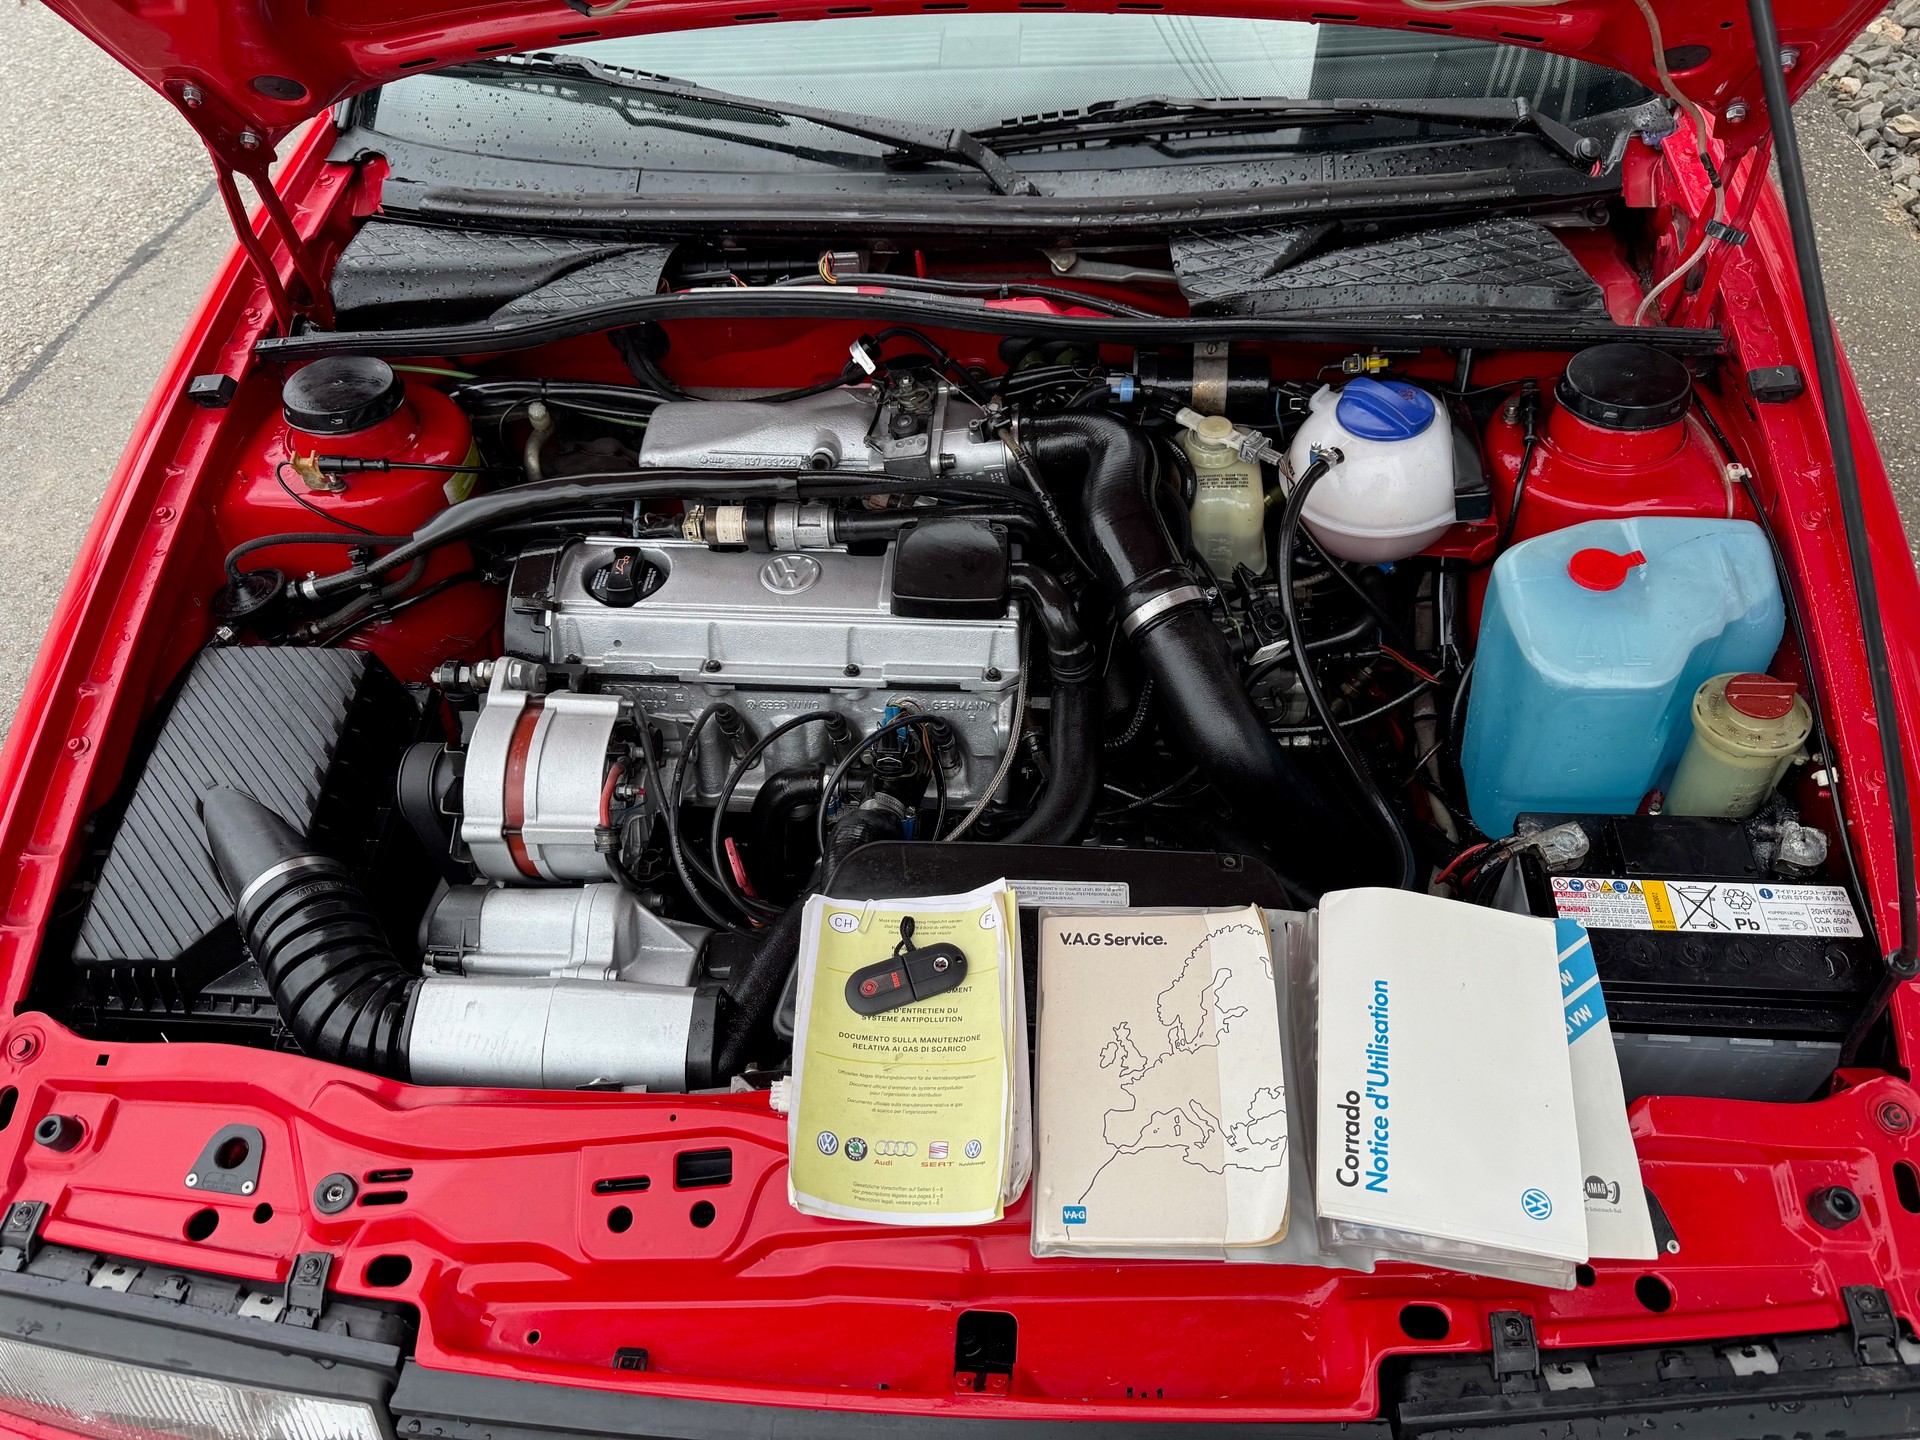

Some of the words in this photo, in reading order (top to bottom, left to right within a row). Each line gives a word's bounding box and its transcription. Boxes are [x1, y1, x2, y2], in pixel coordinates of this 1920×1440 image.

[932, 700, 991, 710] GERMANY
[834, 917, 853, 928] CH
[1734, 918, 1760, 930] Pb
[1060, 932, 1101, 946] V.A.G
[1104, 932, 1168, 946] Service.
[1560, 969, 1574, 987] W
[861, 1014, 898, 1022] SYSTEME
[1568, 1004, 1592, 1027] VW
[838, 1032, 890, 1043] DOCUMENTO
[920, 1034, 981, 1043] MANUTENZIONE
[852, 1043, 890, 1051] RELATIVA
[1365, 979, 1390, 1110] d'Utilisation
[847, 1098, 872, 1106] Documento
[1335, 1089, 1361, 1188] Corrado
[1365, 1116, 1389, 1194] Notice
[1586, 1182, 1606, 1194] AMAG
